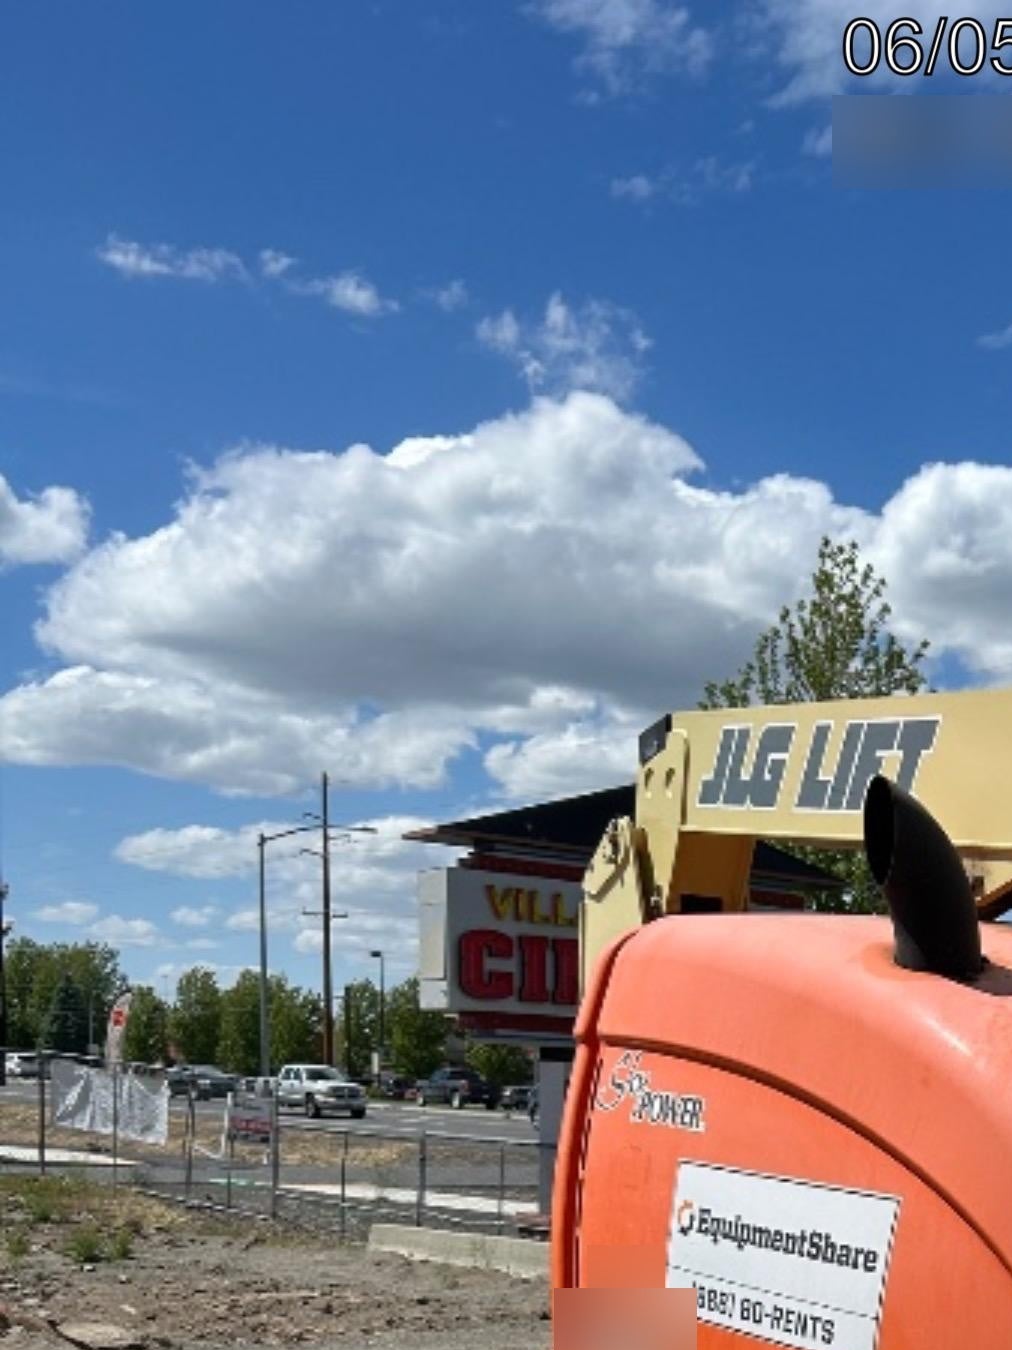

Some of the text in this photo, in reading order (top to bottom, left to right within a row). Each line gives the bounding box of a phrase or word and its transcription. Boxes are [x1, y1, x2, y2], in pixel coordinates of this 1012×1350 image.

[697, 715, 943, 813] JLG LIFT
[485, 884, 579, 927] VILL
[694, 1208, 879, 1273] EquipmentShare
